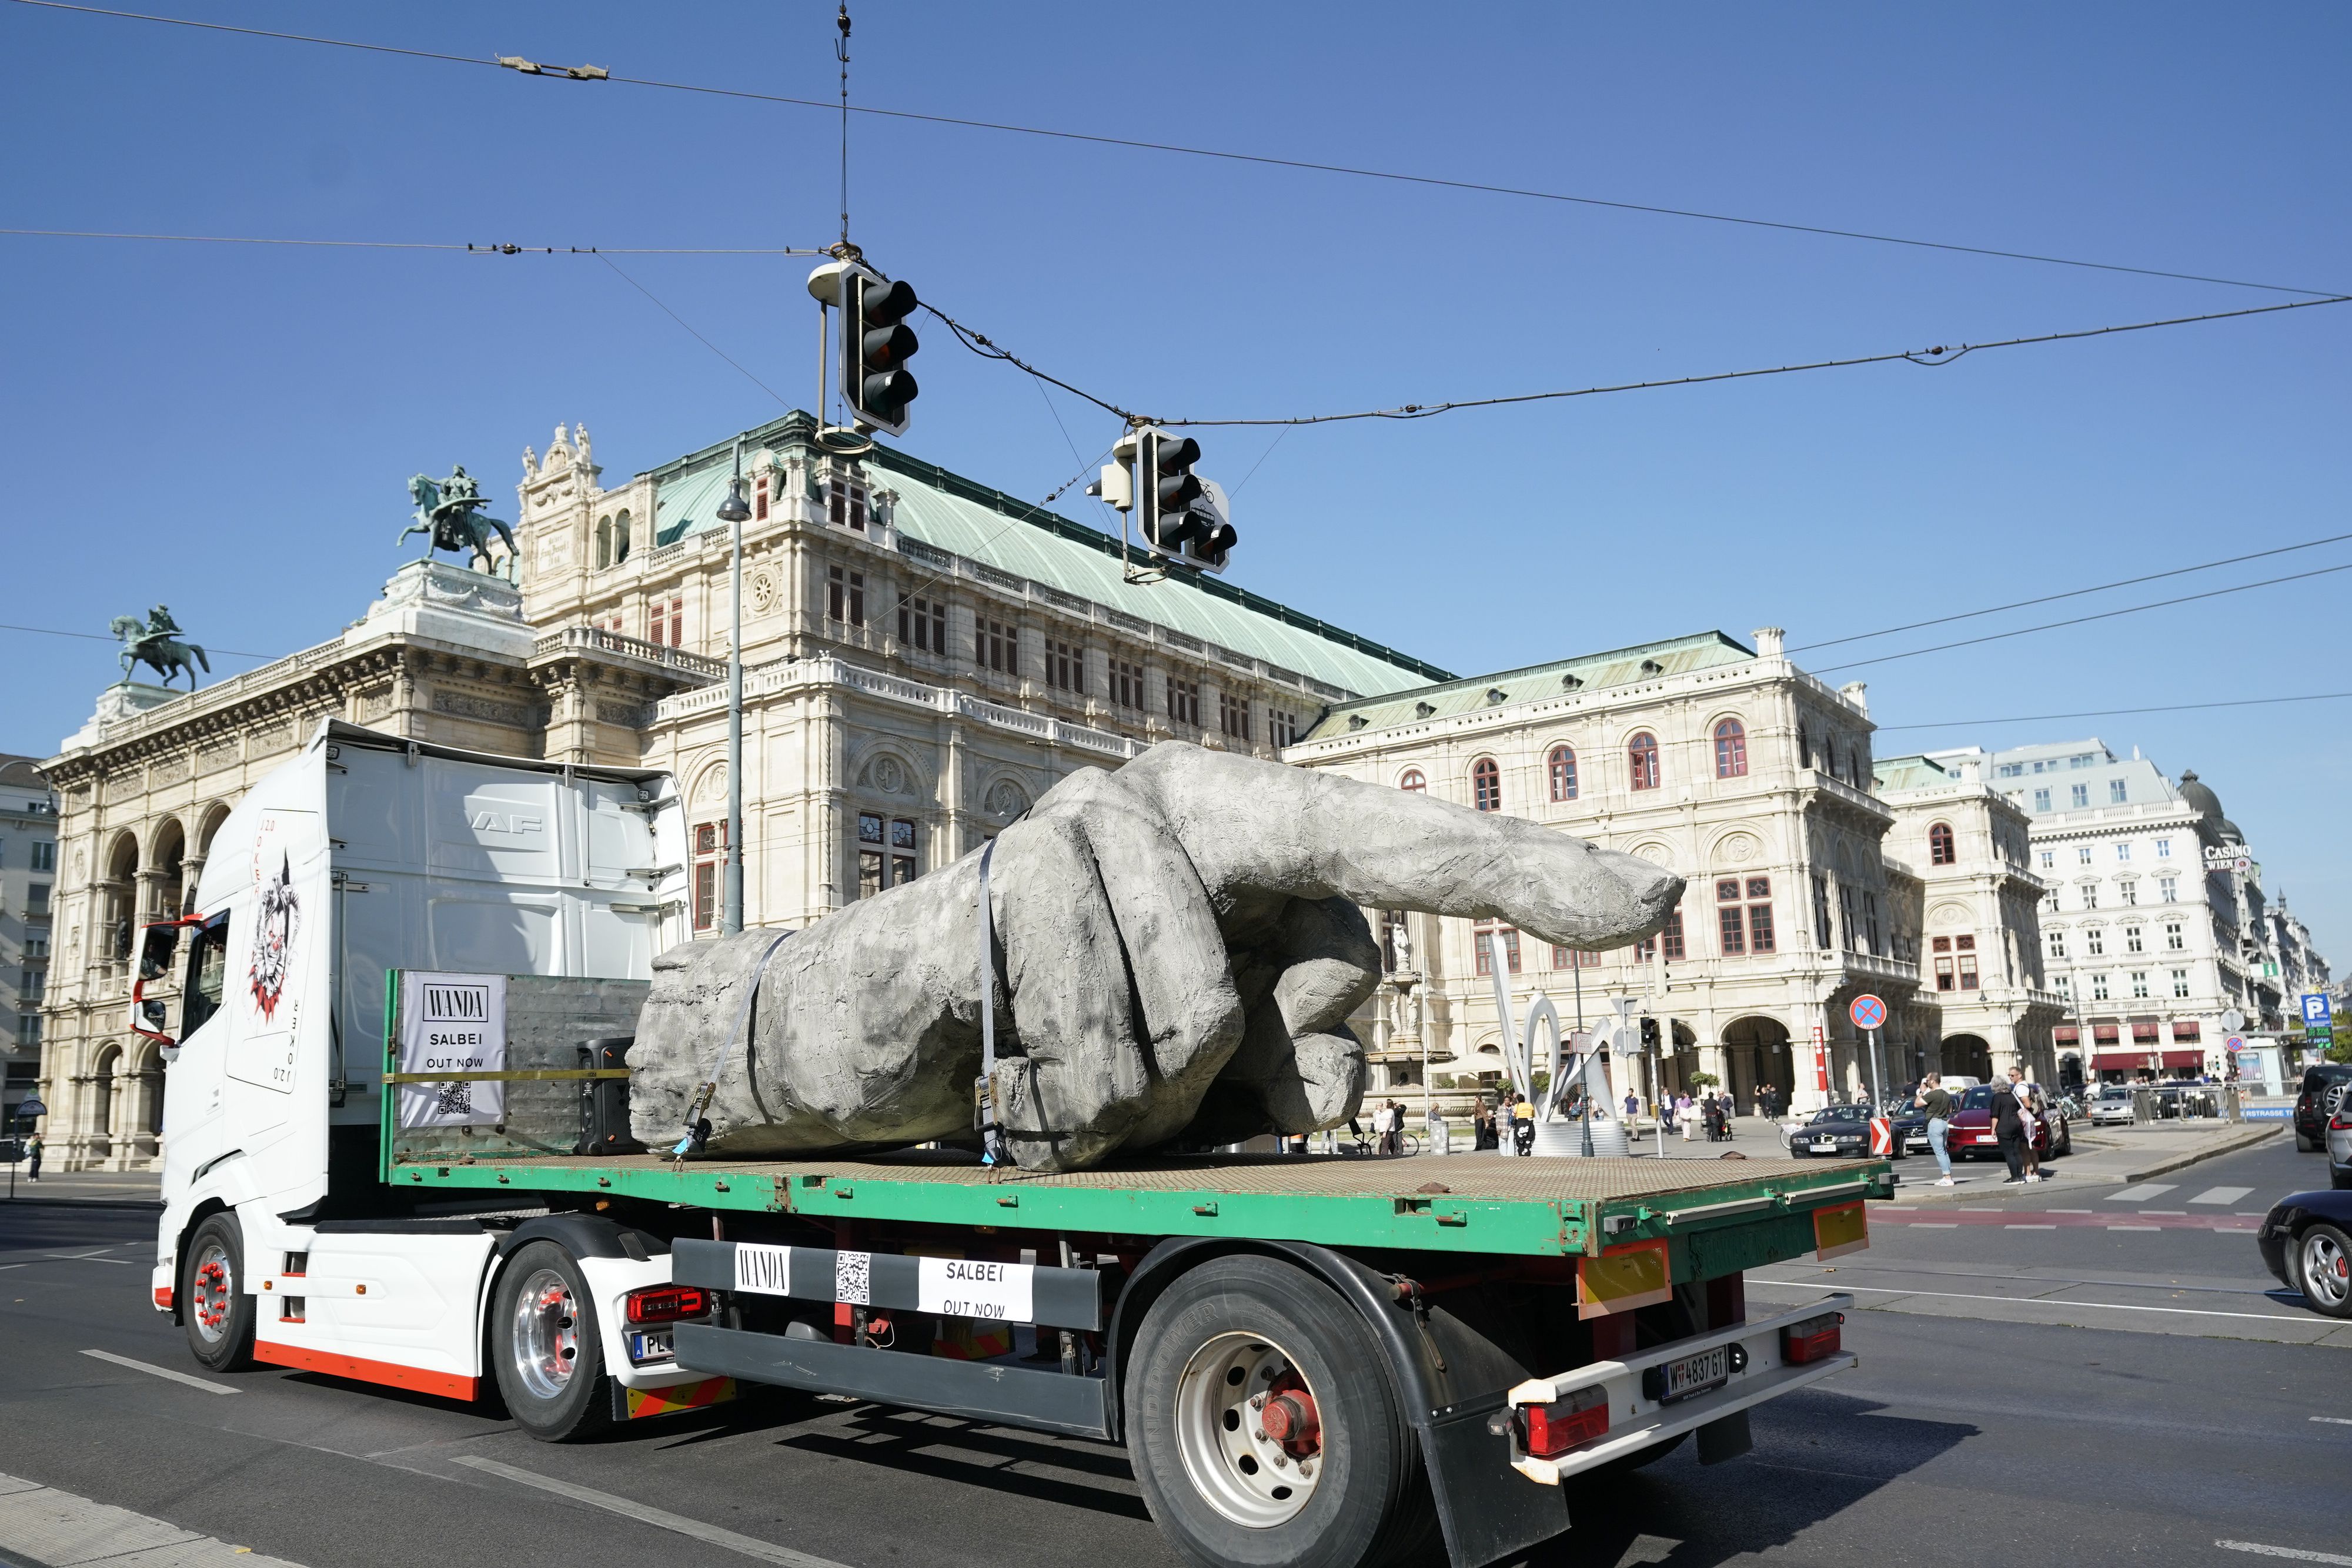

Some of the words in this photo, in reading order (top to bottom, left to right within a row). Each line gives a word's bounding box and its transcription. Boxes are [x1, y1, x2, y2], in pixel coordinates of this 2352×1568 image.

[2205, 844, 2251, 860] CASINO
[2207, 859, 2233, 870] WIEN
[429, 990, 483, 1017] WANDA
[430, 1034, 482, 1045] SALBEI
[427, 1058, 452, 1068] OUT
[457, 1058, 483, 1068] NOW
[740, 1250, 785, 1290] WANDA
[947, 1262, 1004, 1282] SALBEI
[944, 1300, 970, 1315] OUT
[974, 1303, 1005, 1318] NOW
[647, 1335, 666, 1355] PL
[1148, 1303, 1218, 1392] POWER
[1671, 1365, 1678, 1390] W
[1686, 1356, 1709, 1385] 4837
[1712, 1352, 1723, 1376] GT
[1147, 1395, 1174, 1490] WIND
